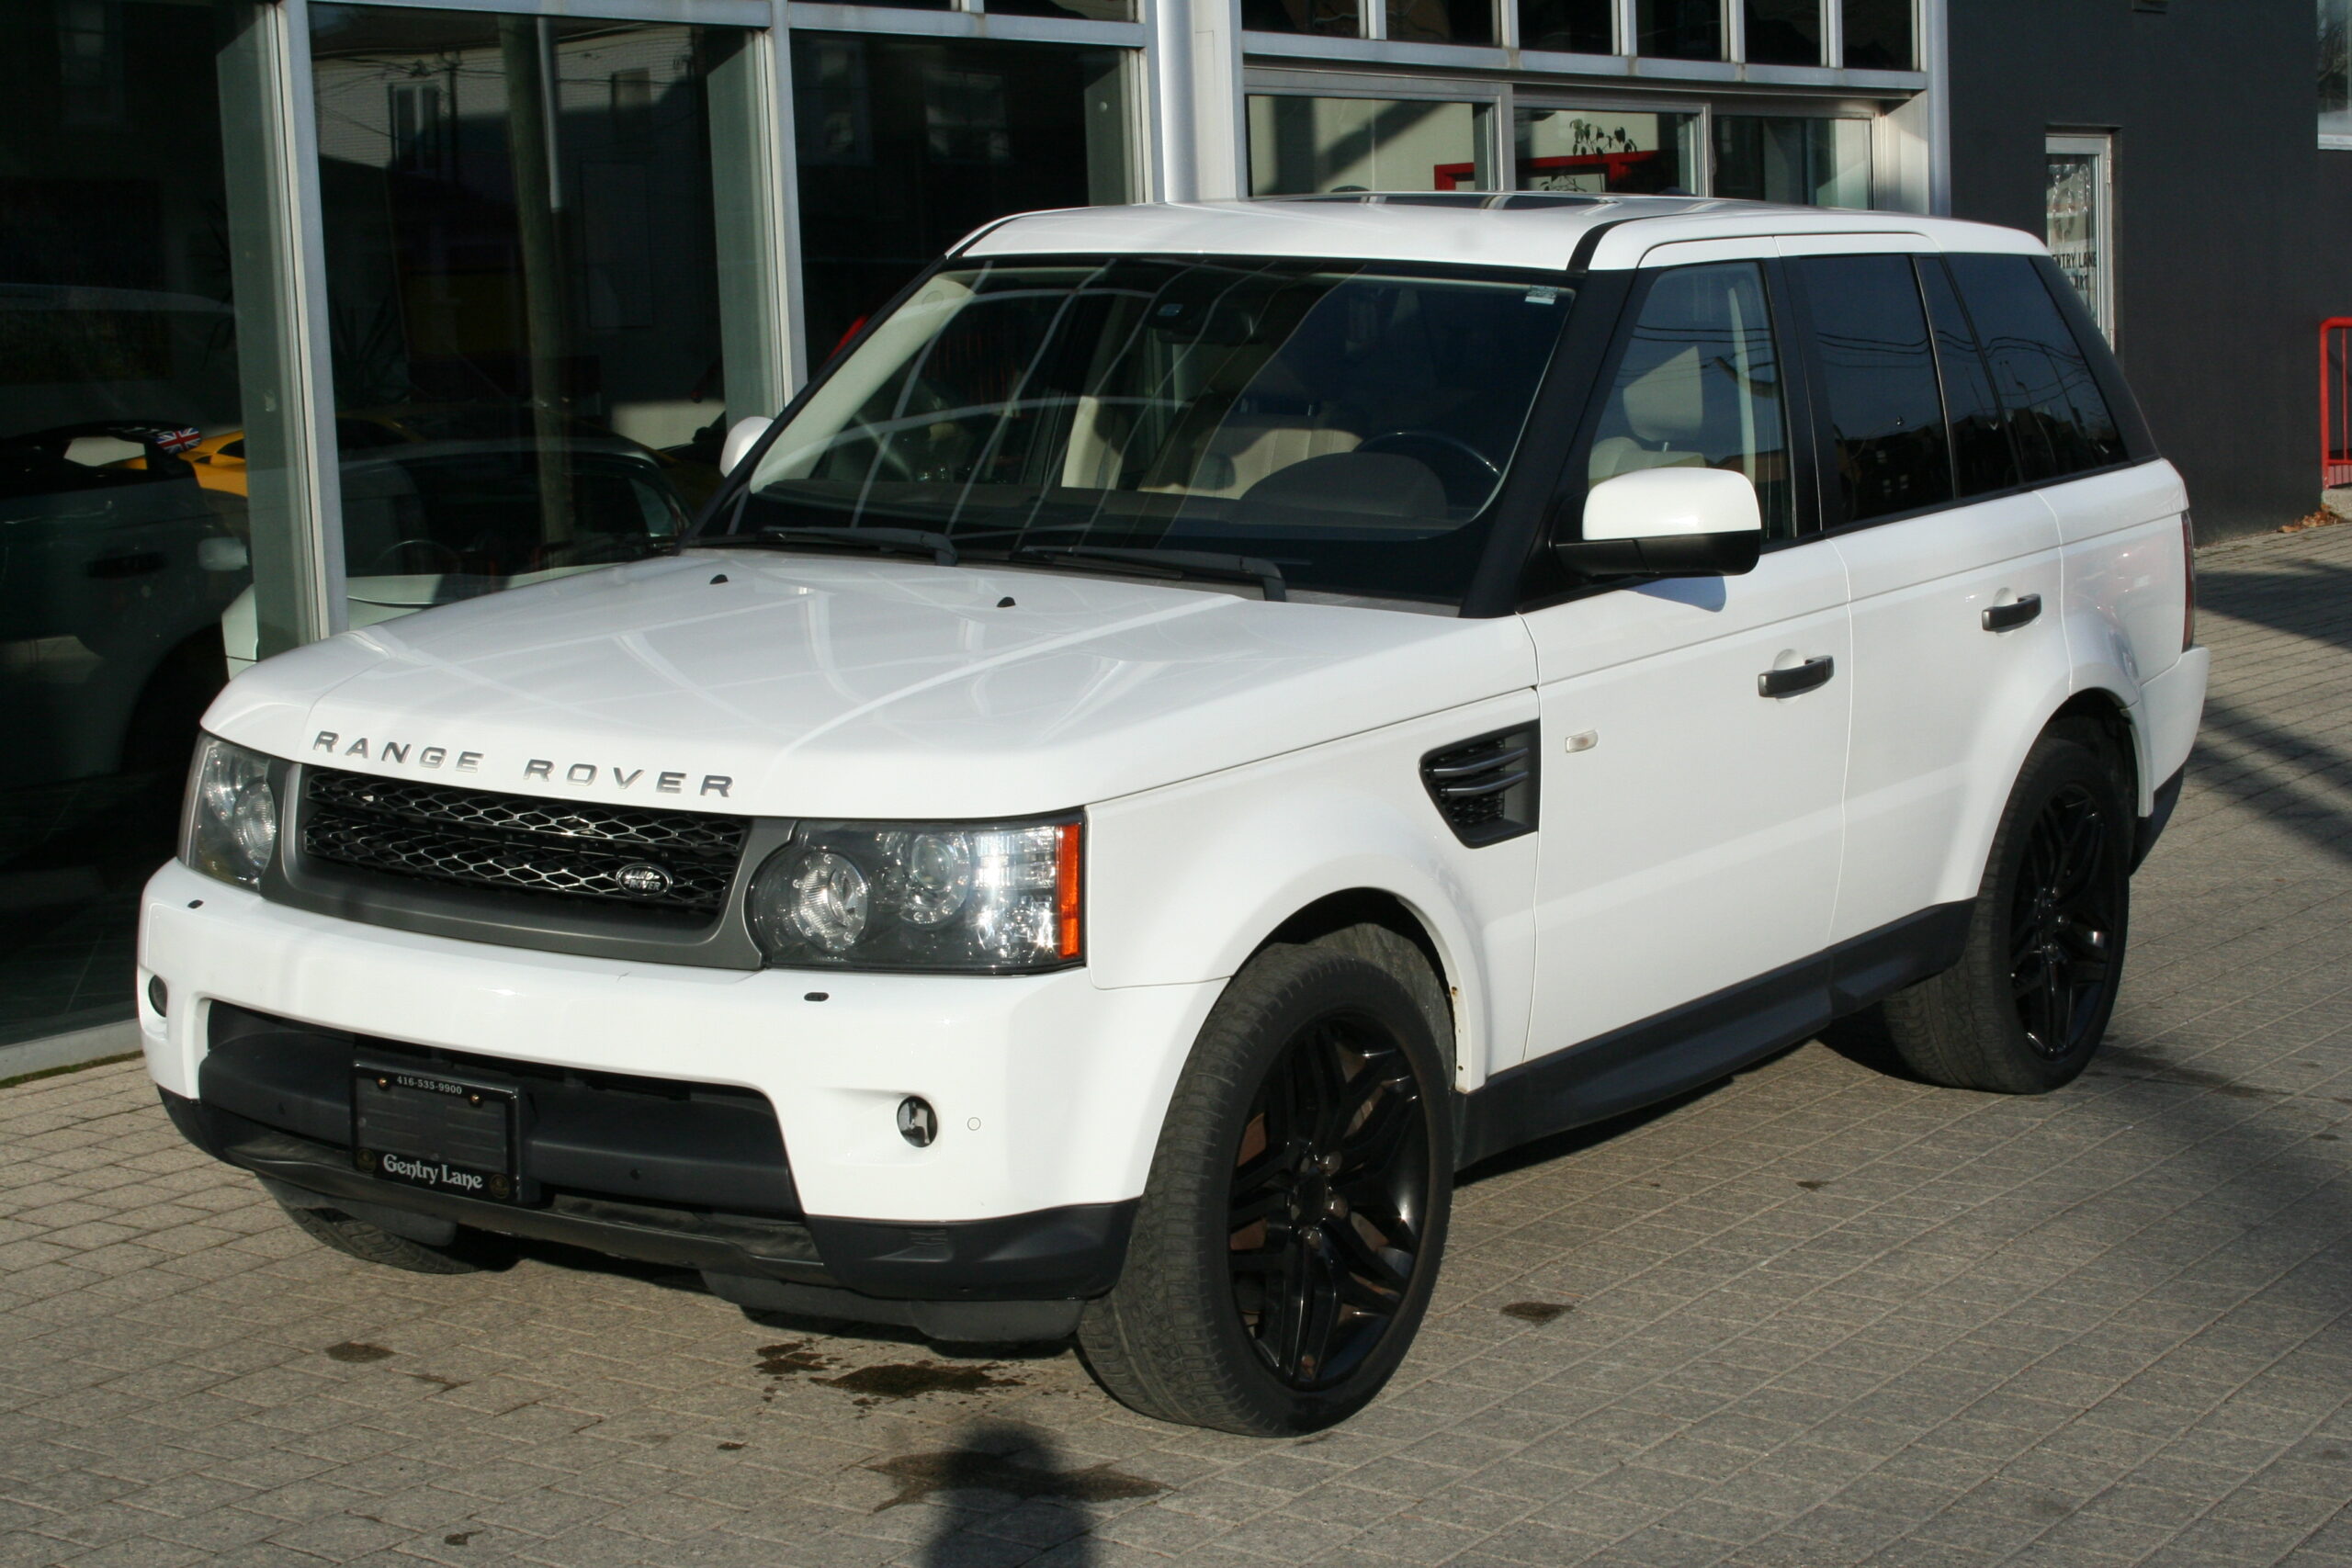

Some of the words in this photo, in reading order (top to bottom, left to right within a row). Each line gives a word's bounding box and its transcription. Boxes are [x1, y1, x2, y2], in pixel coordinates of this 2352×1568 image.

[313, 730, 484, 773] RANGE
[523, 759, 733, 797] ROVER
[396, 1075, 462, 1095] 416-535-9900
[383, 1154, 438, 1185] Gentry
[441, 1164, 483, 1190] Lane
